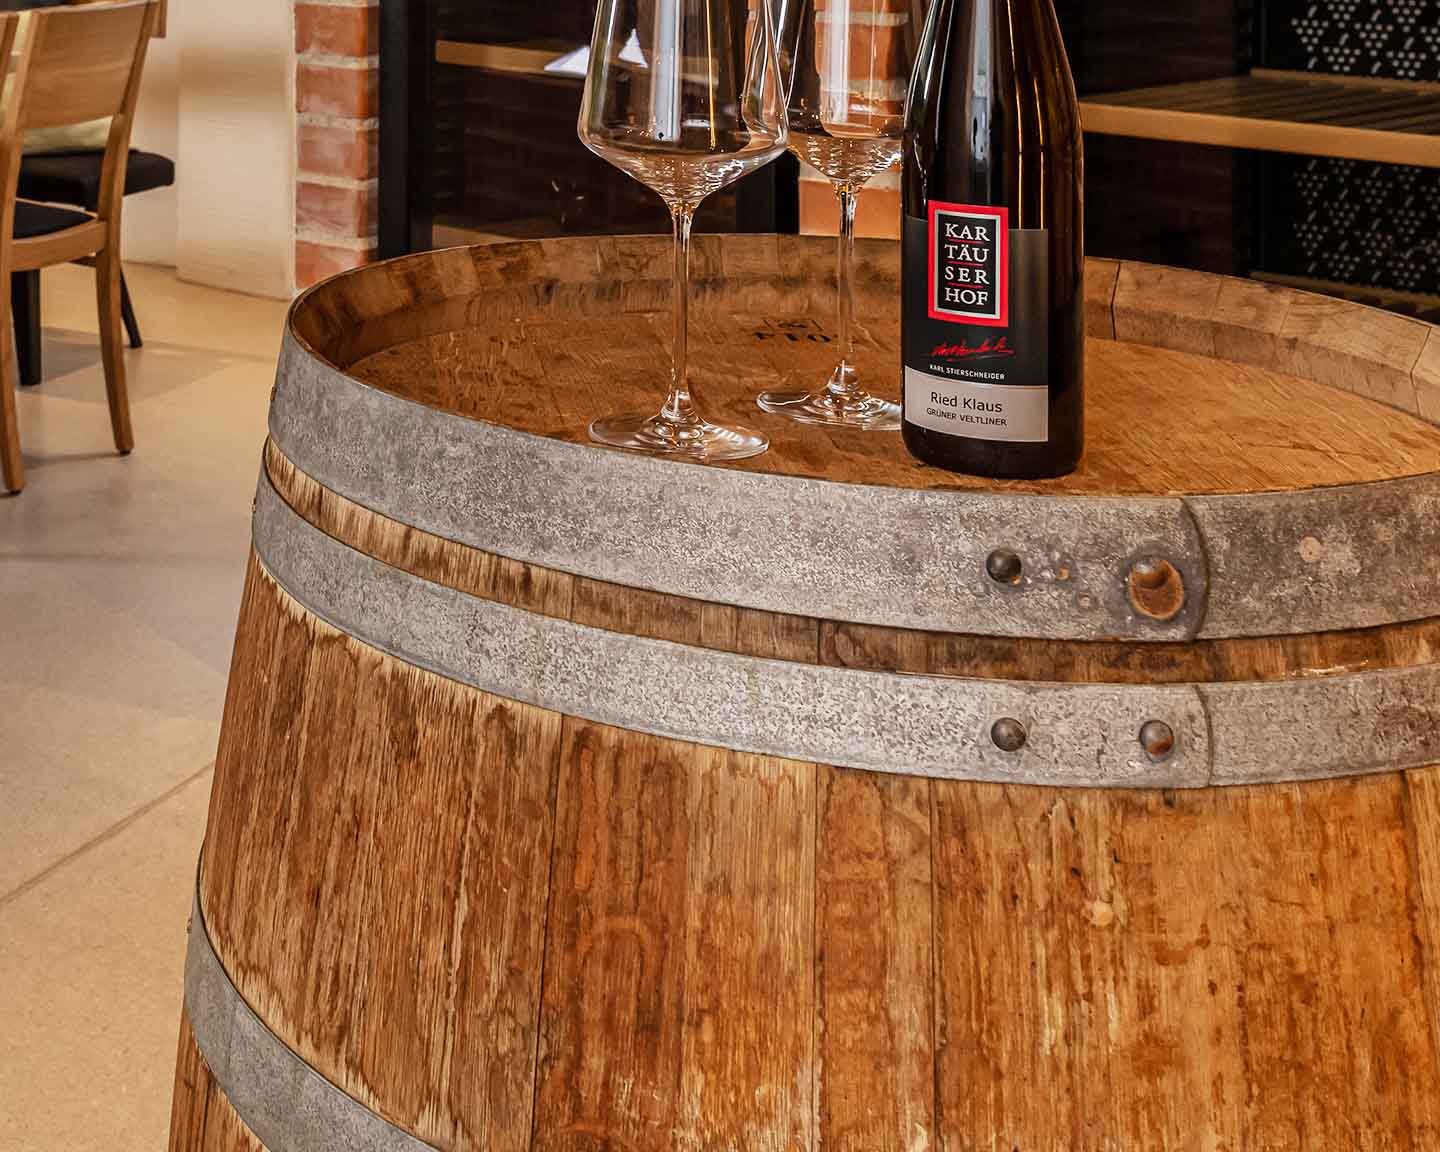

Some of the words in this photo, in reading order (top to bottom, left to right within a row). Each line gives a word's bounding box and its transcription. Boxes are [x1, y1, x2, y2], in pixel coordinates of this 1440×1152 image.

[944, 223, 991, 242] KAR
[944, 244, 990, 262] TÄU
[944, 266, 990, 285] SER
[944, 287, 989, 305] HOF
[929, 364, 944, 373] KARL
[946, 367, 1005, 380] STIERSCHNEIDER
[931, 391, 958, 407] Ried
[963, 397, 1003, 413] Klaus
[960, 414, 1008, 426] VELTLINER
